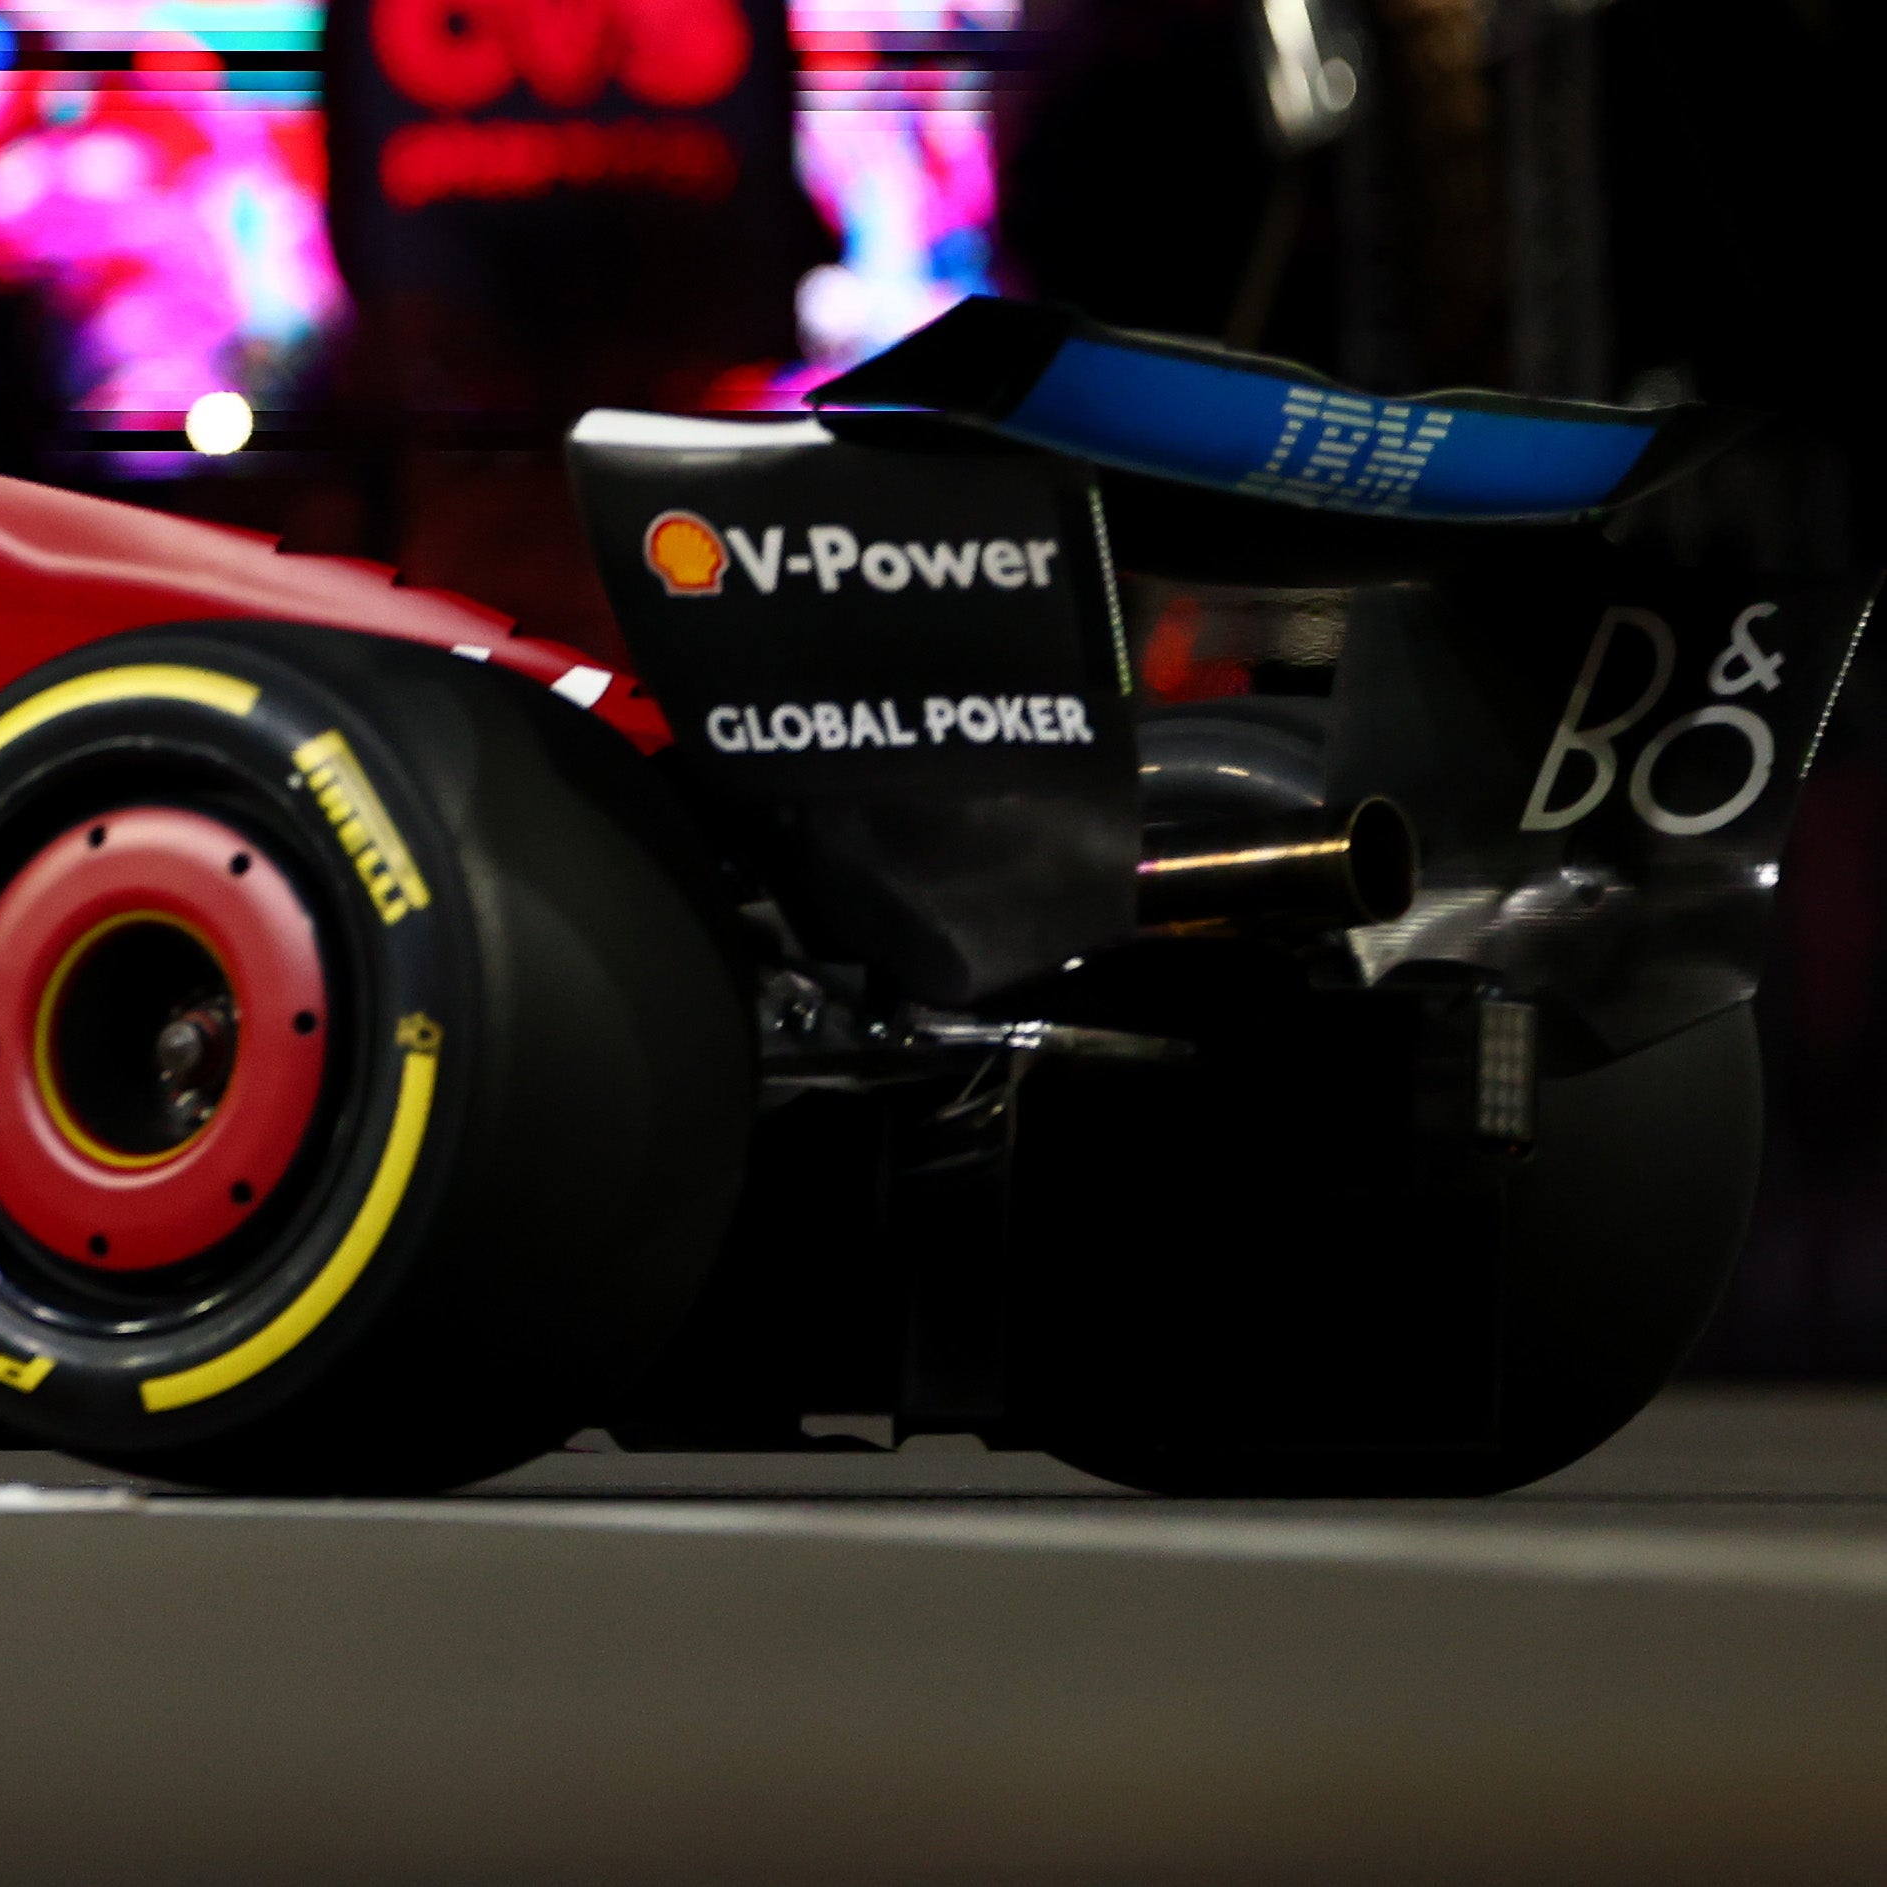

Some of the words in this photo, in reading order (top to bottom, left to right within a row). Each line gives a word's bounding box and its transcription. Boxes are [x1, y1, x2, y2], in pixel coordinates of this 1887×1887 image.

[1236, 386, 1454, 514] IBM
[725, 524, 1059, 595] V-Power
[705, 700, 918, 753] GLOBAL
[924, 695, 1094, 745] POKER
